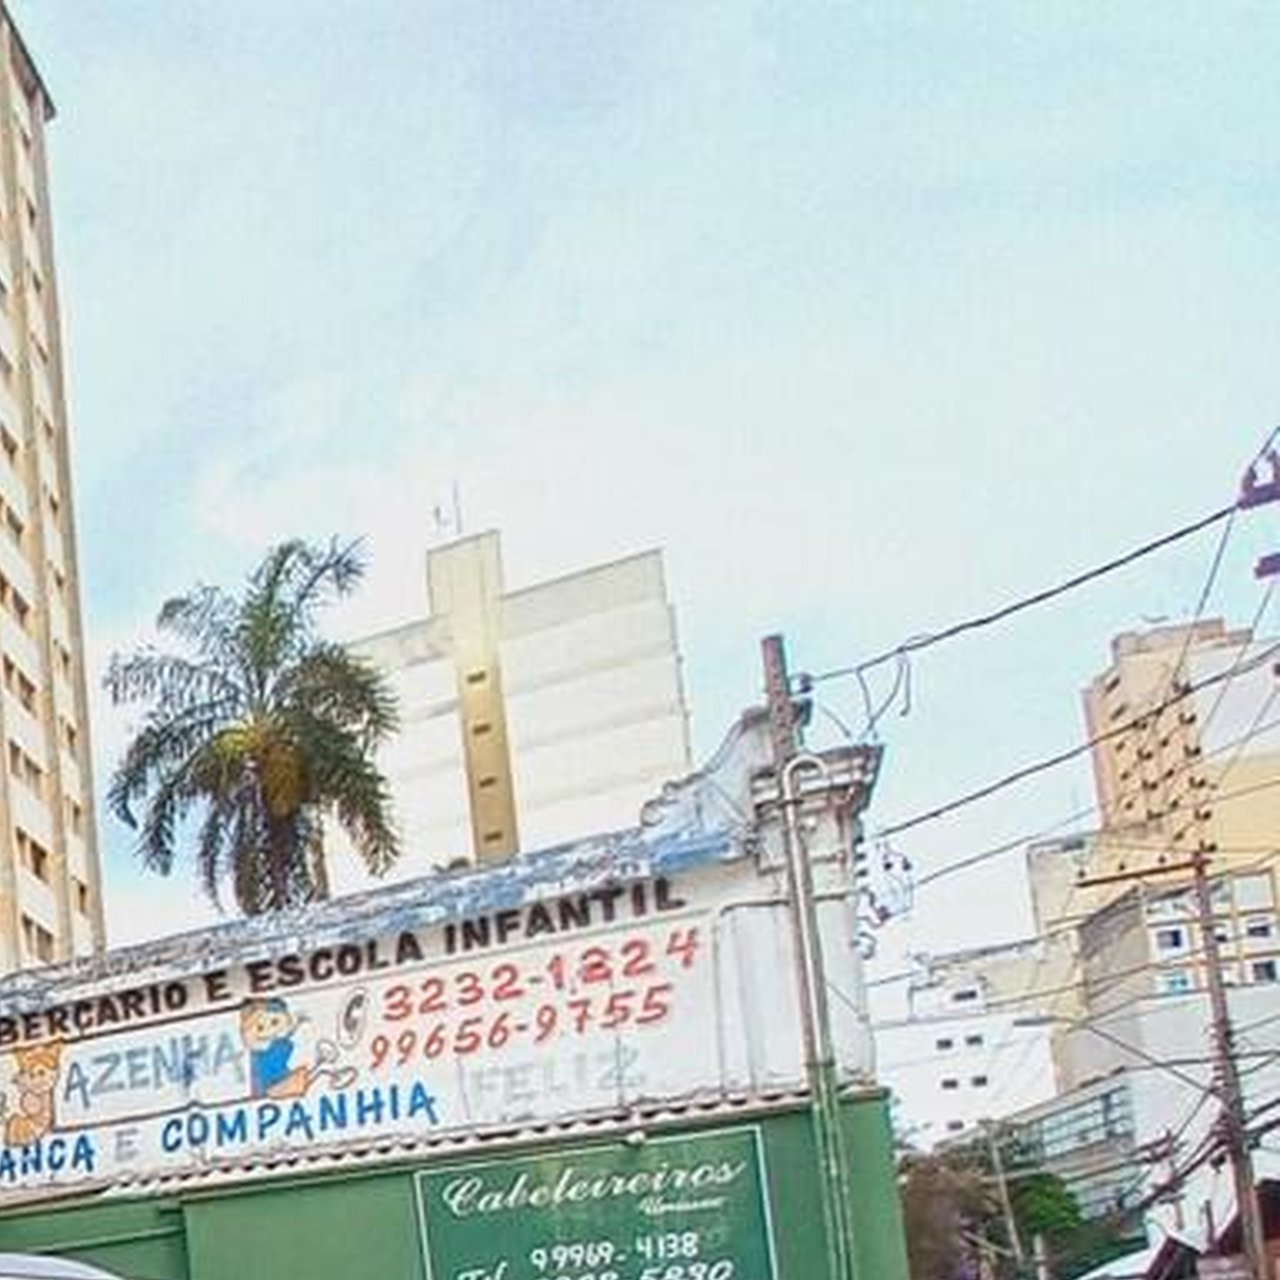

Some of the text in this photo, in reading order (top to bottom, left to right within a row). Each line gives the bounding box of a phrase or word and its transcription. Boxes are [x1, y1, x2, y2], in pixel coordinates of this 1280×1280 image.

[204, 969, 231, 1003] E
[246, 931, 425, 994] ESCOLA
[444, 877, 688, 954] INFANTIL
[371, 984, 673, 1069] 99656-9755
[114, 1127, 139, 1162] E
[161, 1081, 439, 1151] COMPANHIA
[442, 1160, 748, 1217] Cabeleireiros
